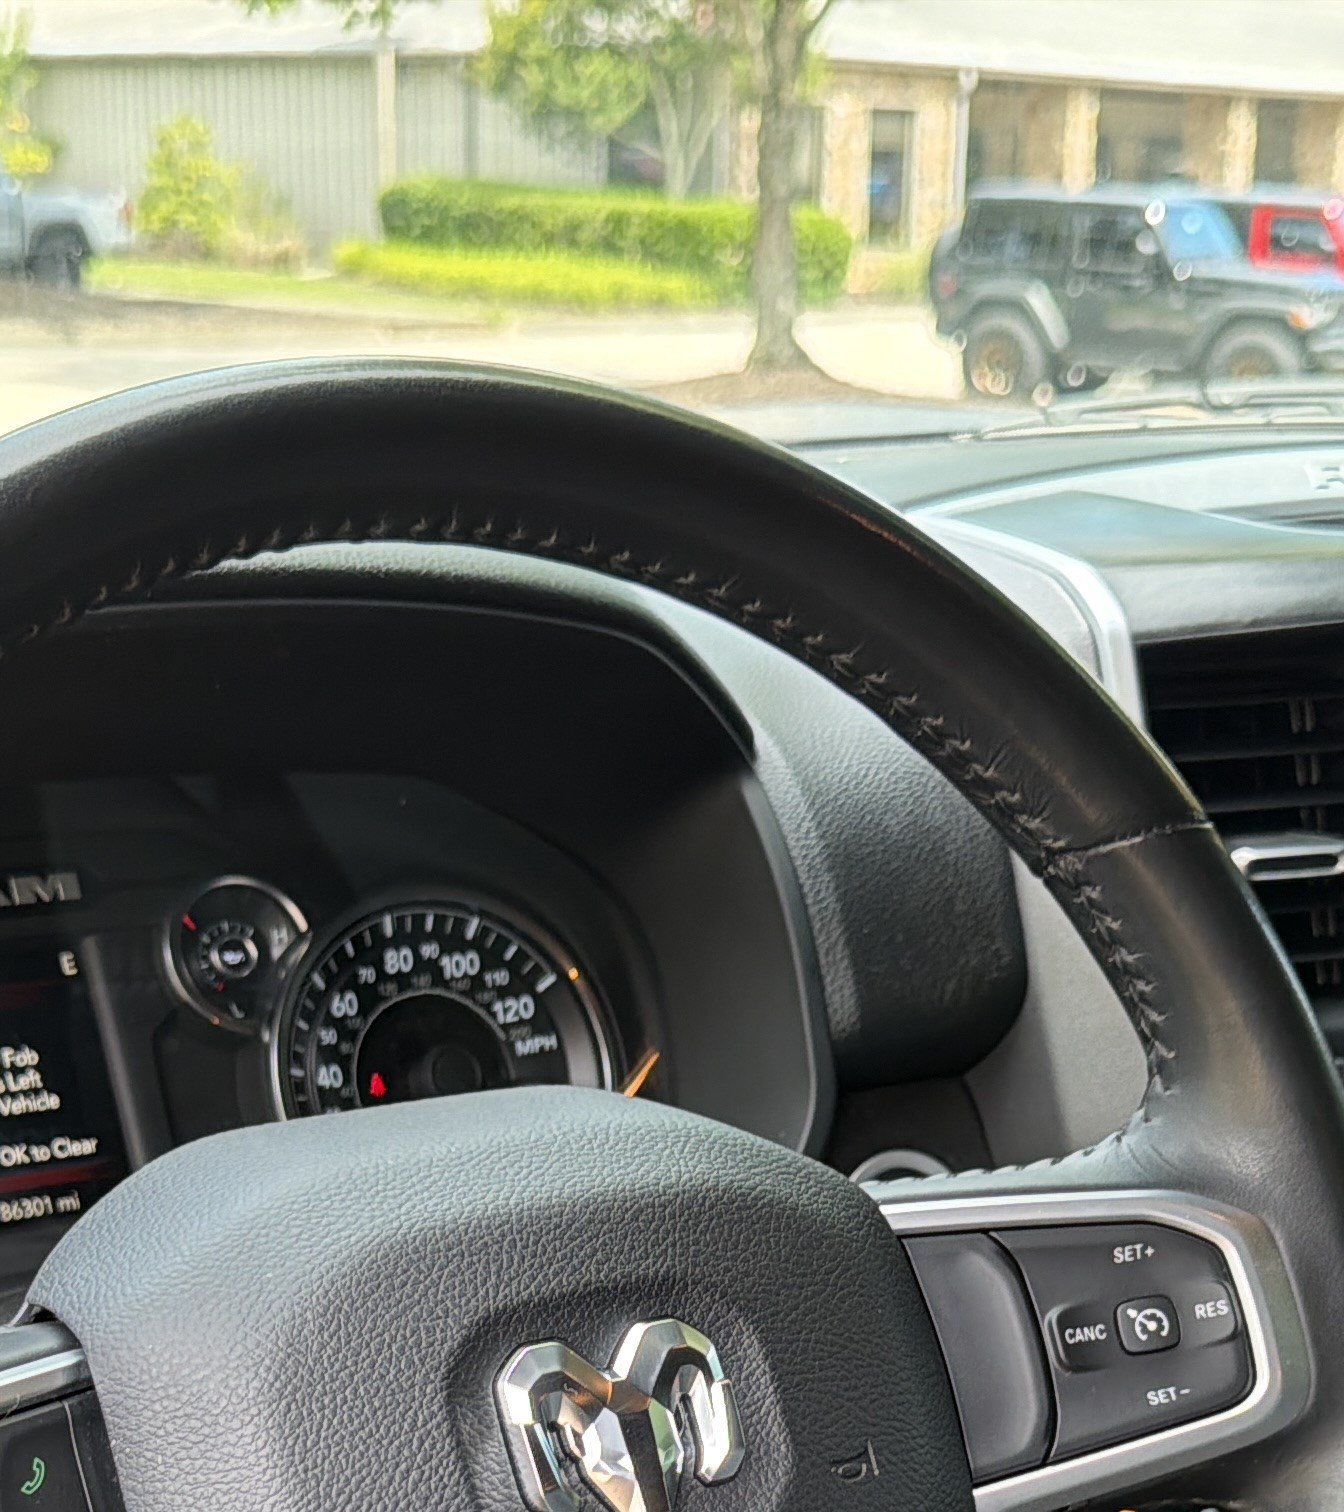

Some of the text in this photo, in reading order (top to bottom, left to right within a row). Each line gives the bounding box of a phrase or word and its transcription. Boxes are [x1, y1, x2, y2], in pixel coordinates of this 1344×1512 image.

[58, 950, 78, 976] E
[383, 947, 414, 975] 80
[419, 940, 440, 961] 90
[358, 964, 377, 985] 70
[438, 950, 481, 981] 100
[483, 967, 510, 988] 110
[330, 990, 359, 1018] 60
[492, 993, 536, 1025] 120
[320, 1027, 338, 1046] 50
[514, 1033, 559, 1057] MPH
[0, 1044, 40, 1069] Fob
[4, 1067, 44, 1093] Left
[317, 1063, 344, 1089] 40
[29, 1144, 51, 1162] to
[51, 1135, 99, 1159] Clear
[57, 1189, 81, 1213] mi
[1194, 1300, 1229, 1320] RES
[1064, 1326, 1108, 1345] CANC
